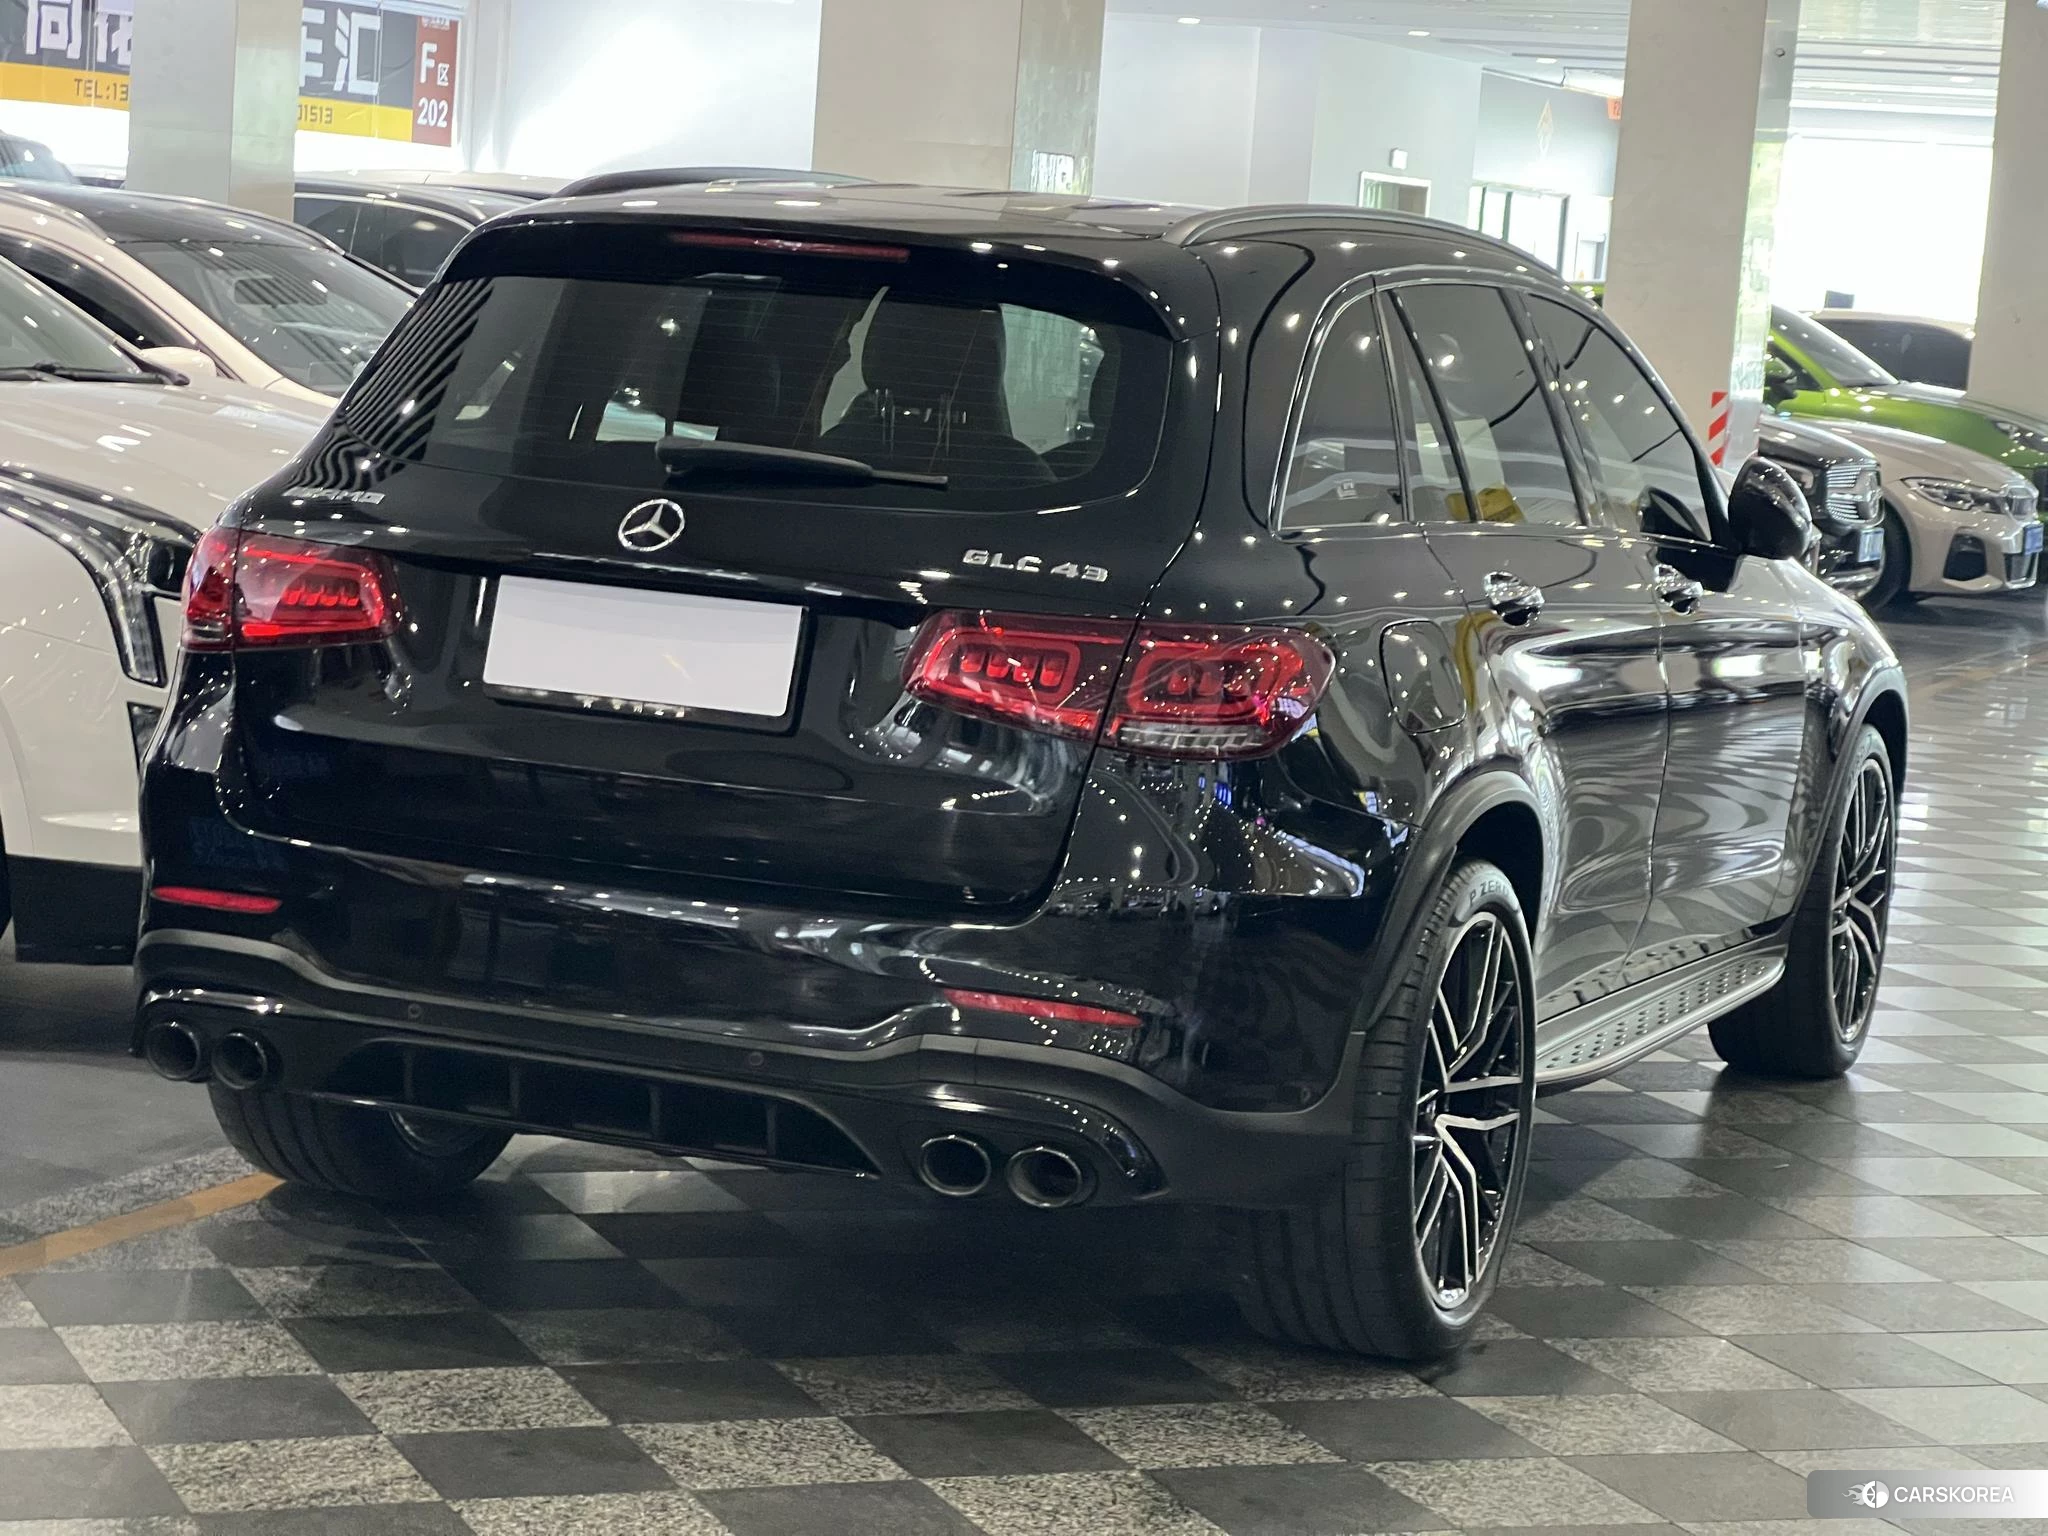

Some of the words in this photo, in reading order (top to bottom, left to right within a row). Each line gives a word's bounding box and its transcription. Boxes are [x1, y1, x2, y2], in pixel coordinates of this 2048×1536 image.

[417, 97, 449, 128] 202
[962, 549, 1043, 573] GLC
[1050, 561, 1109, 583] 43
